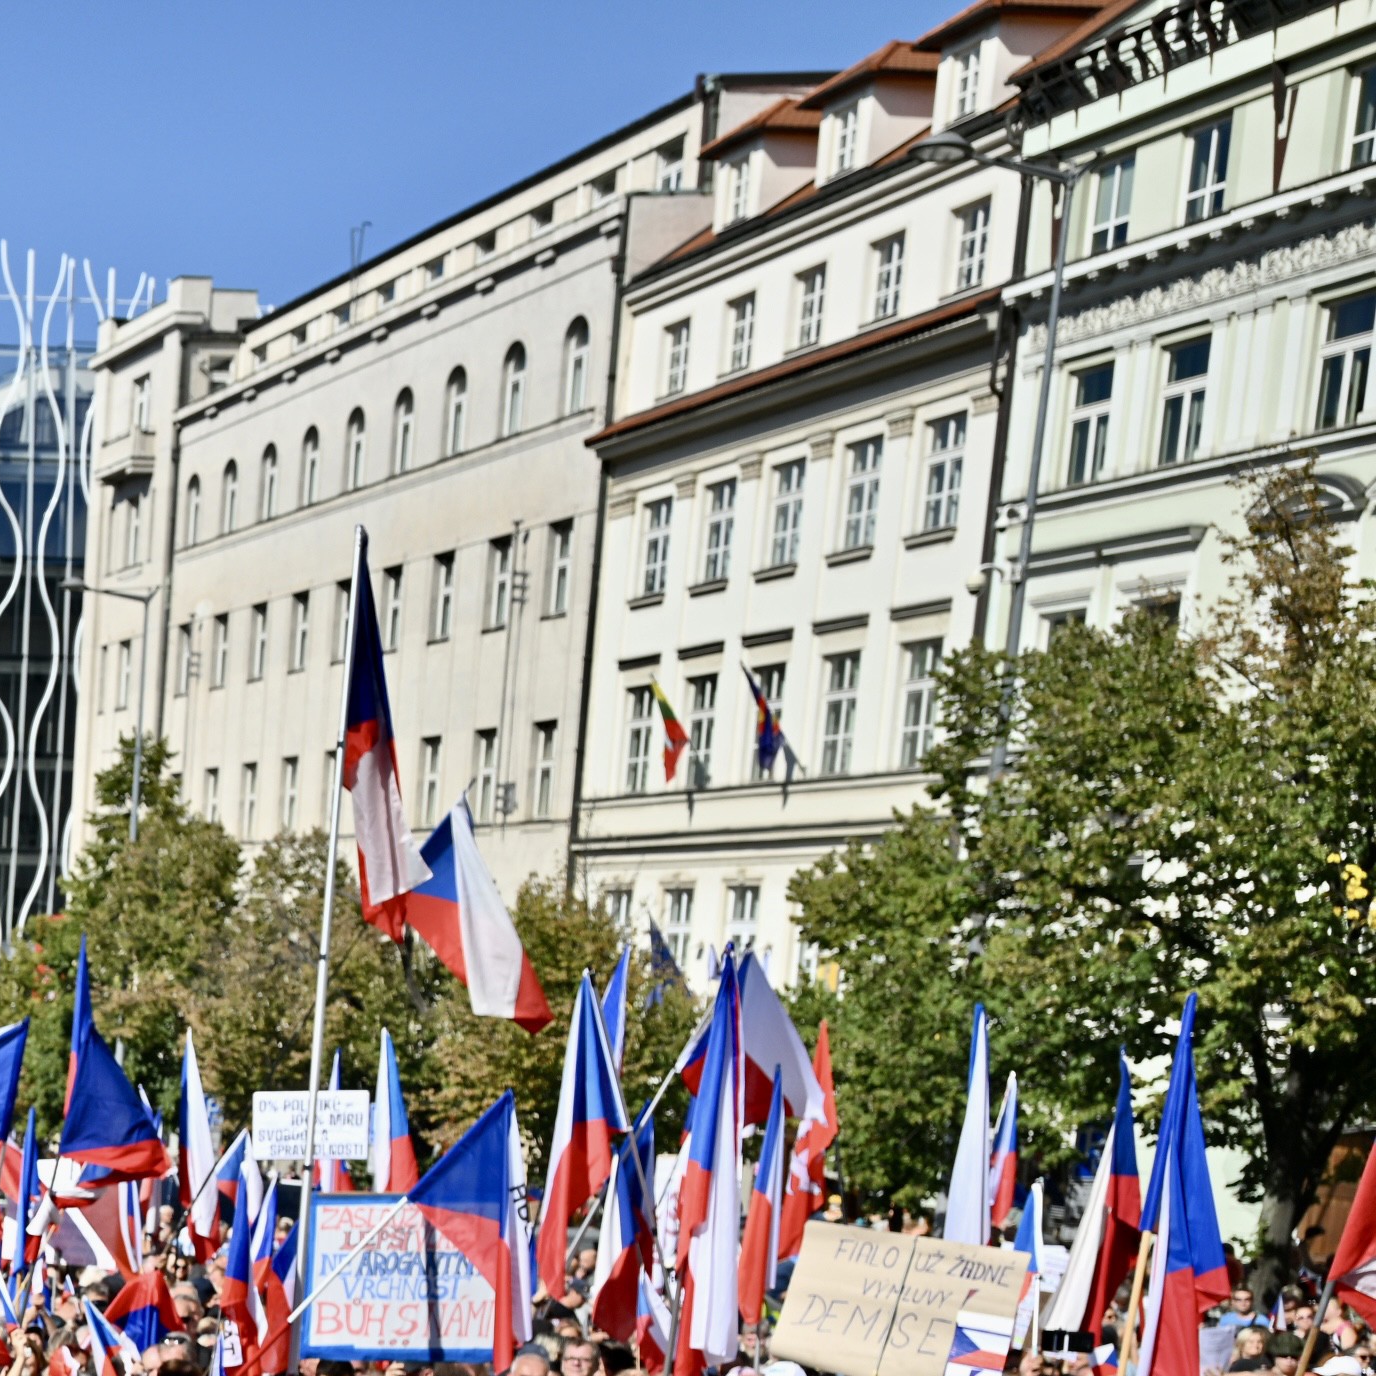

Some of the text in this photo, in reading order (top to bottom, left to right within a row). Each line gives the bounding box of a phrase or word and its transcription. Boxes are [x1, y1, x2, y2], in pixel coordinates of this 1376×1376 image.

[833, 1237, 901, 1270] FIALO
[913, 1249, 946, 1273] UŽ
[315, 1299, 387, 1337] BŮH
[398, 1303, 420, 1337] S
[791, 1293, 953, 1356] DEMISE
